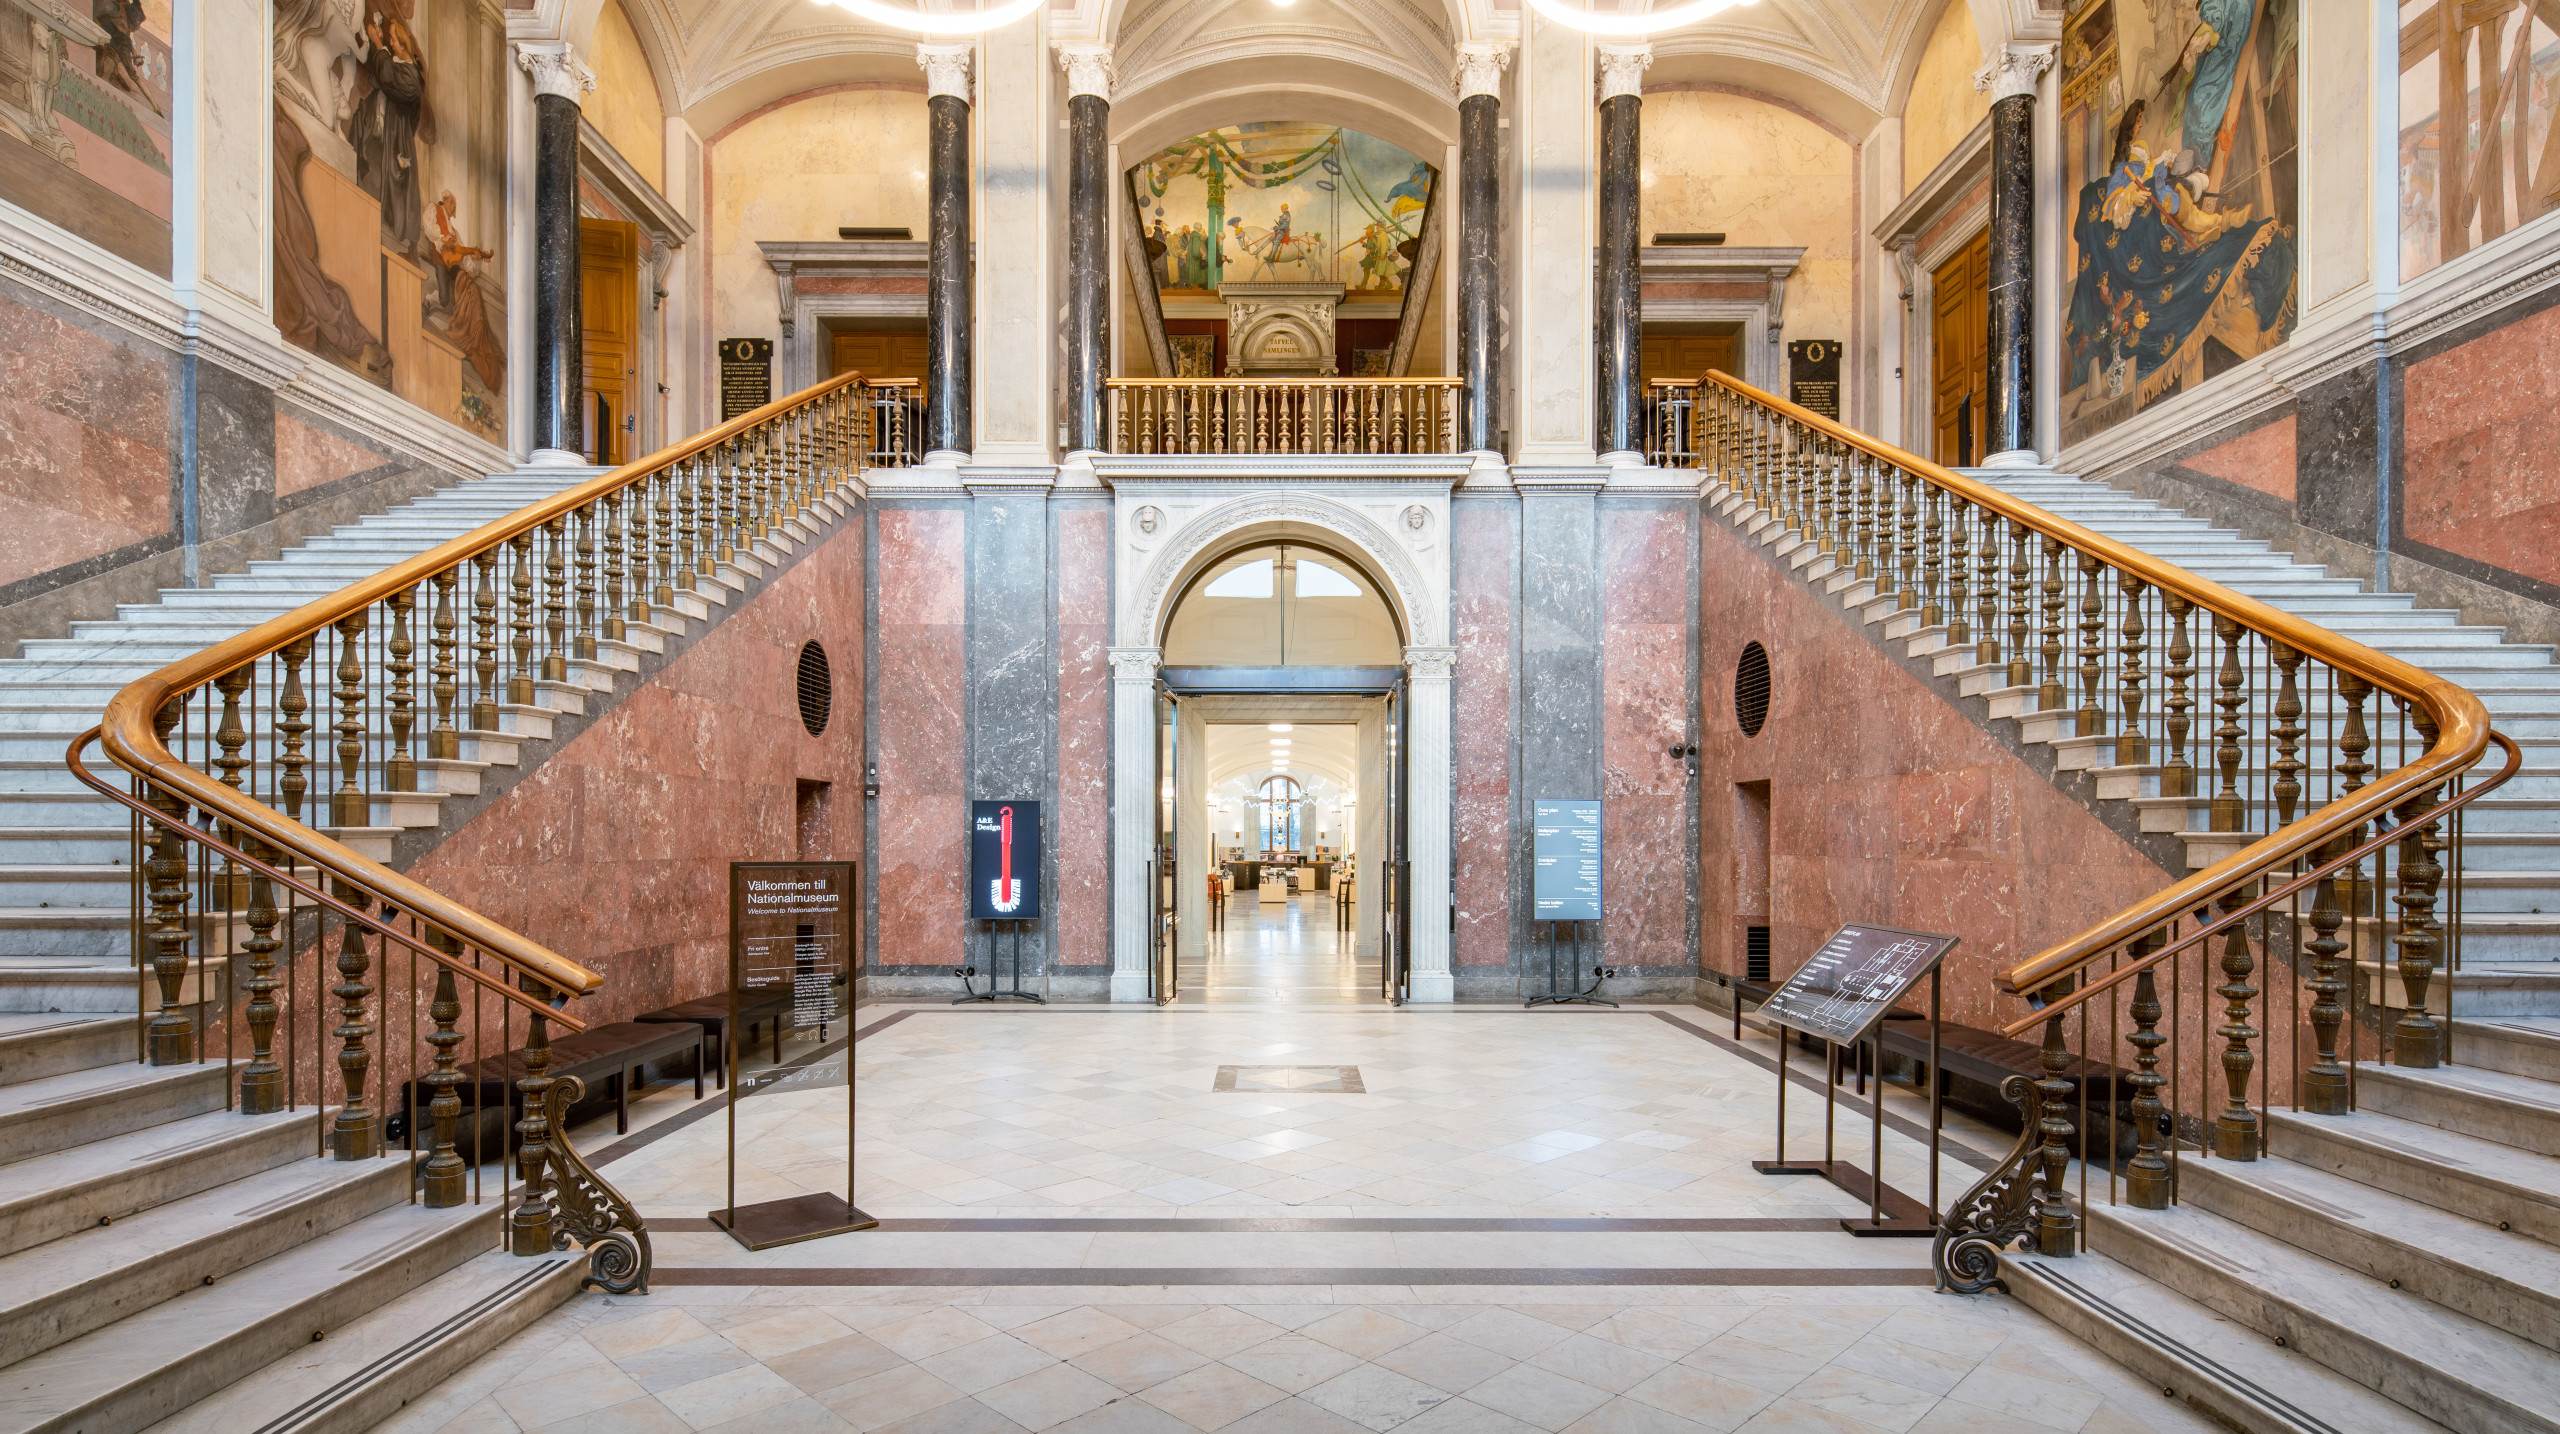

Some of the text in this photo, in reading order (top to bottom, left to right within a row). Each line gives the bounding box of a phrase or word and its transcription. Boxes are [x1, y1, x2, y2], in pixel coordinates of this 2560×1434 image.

[977, 824, 1001, 832] Design
[747, 879, 826, 891] Välkommen till
[747, 892, 839, 904] Nationalmuseum
[747, 907, 778, 915] Welcome
[787, 906, 839, 914] Nationalmuseum
